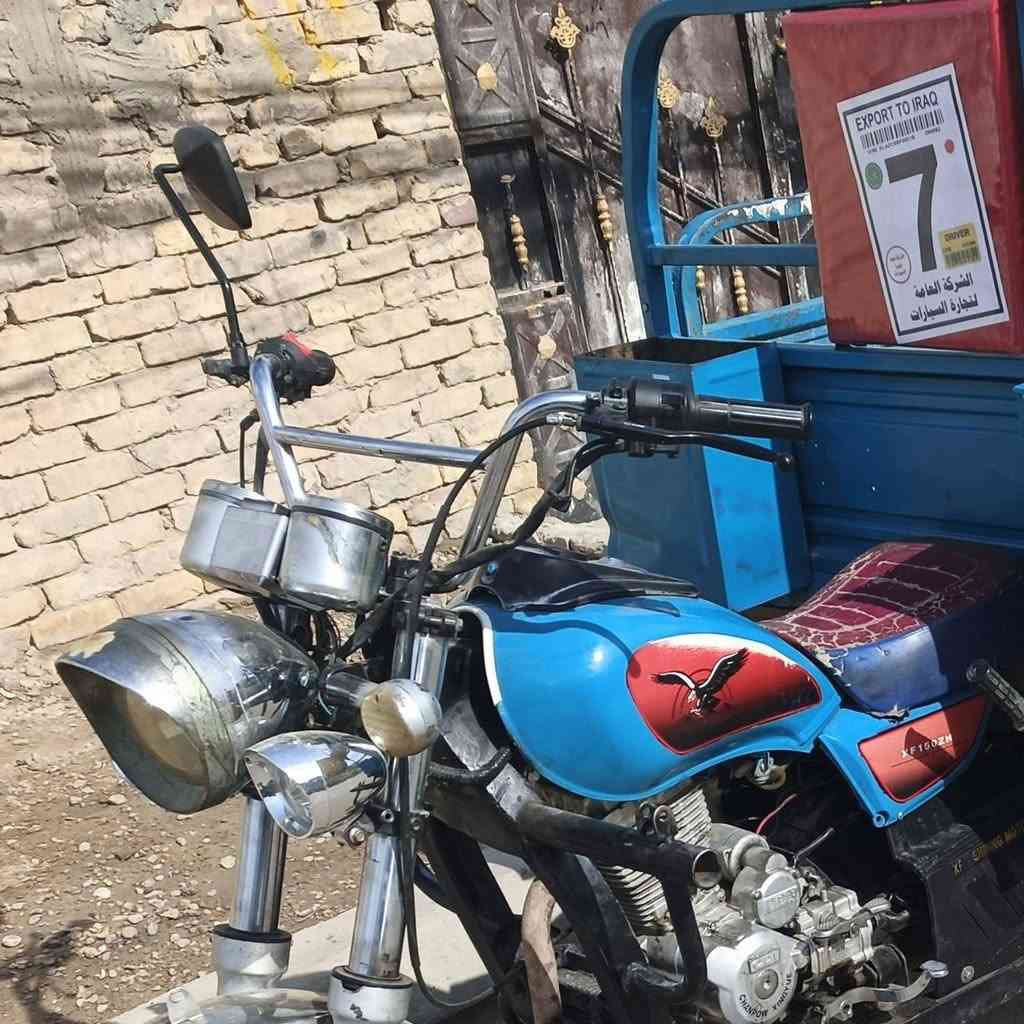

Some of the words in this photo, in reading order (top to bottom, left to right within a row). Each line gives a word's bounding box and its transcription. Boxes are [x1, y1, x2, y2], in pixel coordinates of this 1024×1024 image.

[855, 106, 894, 131] EXPORT
[897, 102, 911, 117] TO
[912, 90, 939, 112] IRAQ
[885, 143, 938, 272] 7
[943, 228, 971, 242] DRIVER
[914, 280, 941, 298] العامة
[943, 272, 973, 293] الشركة
[910, 301, 948, 322] السيارات
[950, 294, 979, 315] لتجارة
